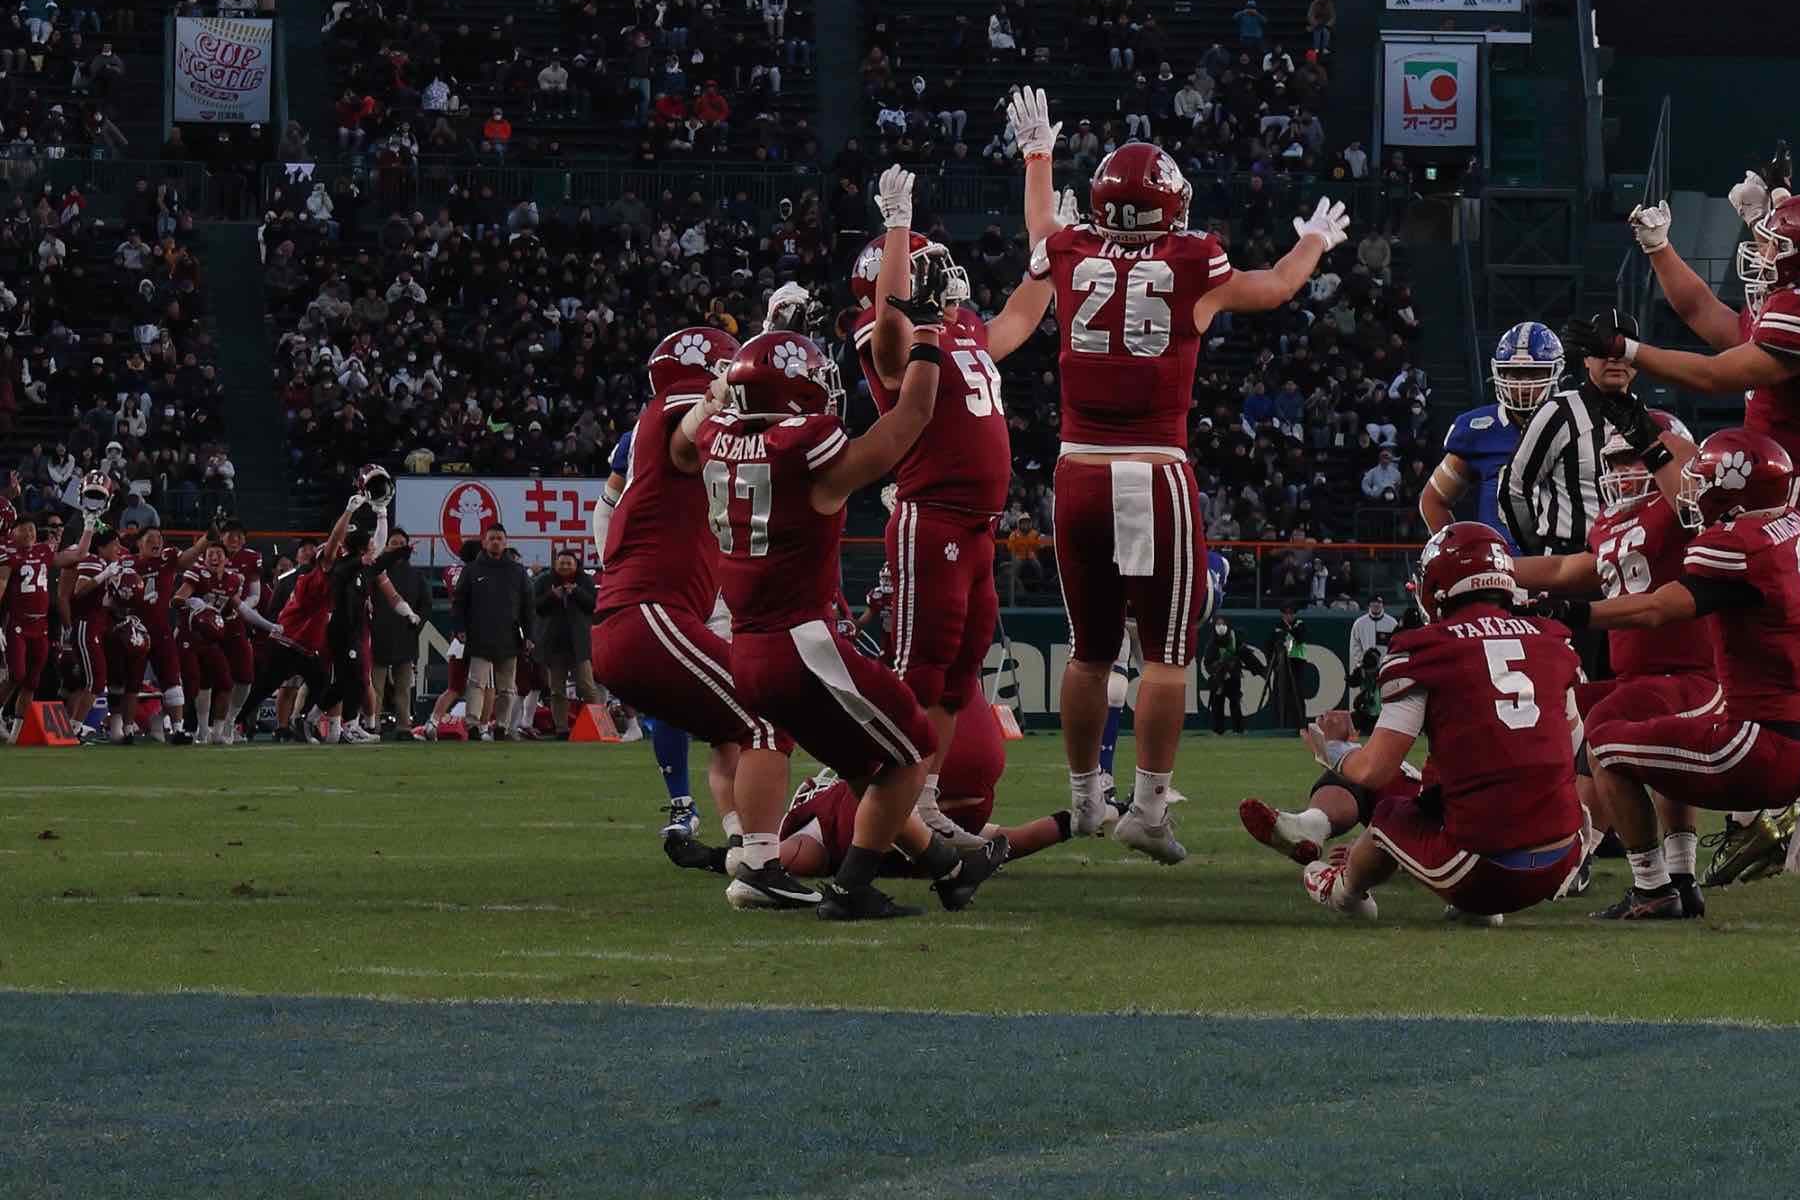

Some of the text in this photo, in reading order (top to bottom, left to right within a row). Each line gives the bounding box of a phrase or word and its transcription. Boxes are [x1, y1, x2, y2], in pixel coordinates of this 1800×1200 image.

[1105, 202, 1136, 230] 26
[1071, 257, 1174, 357] 26
[20, 565, 48, 593] 24
[1597, 526, 1652, 600] 56
[1448, 616, 1541, 638] TAKEDA
[1482, 639, 1541, 730] 5
